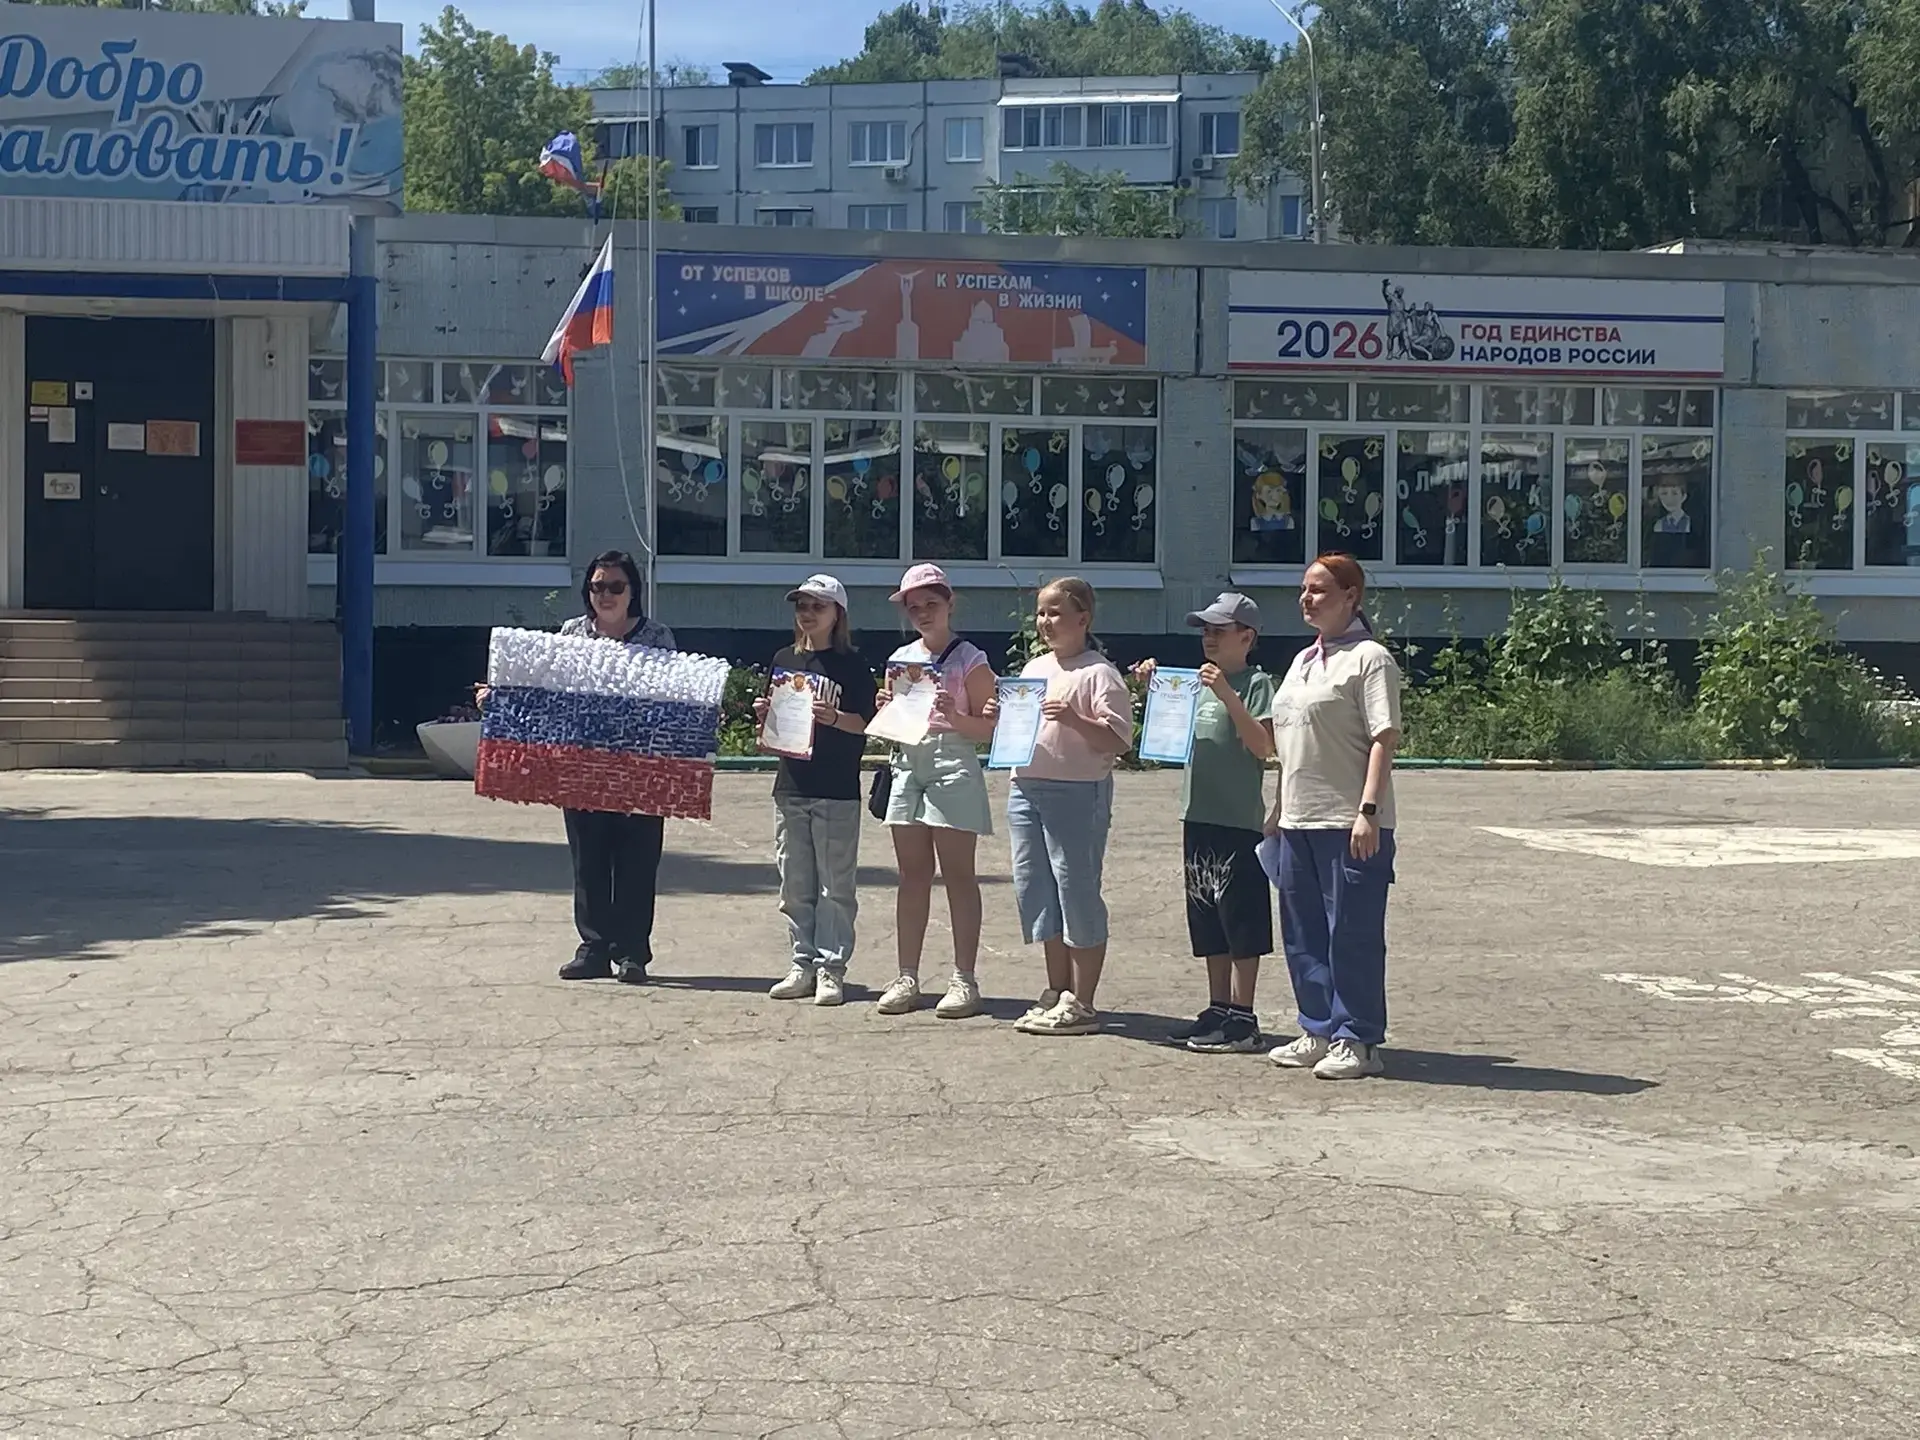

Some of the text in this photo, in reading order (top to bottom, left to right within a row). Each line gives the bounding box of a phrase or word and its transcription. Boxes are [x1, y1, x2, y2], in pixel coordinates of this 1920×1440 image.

[0, 34, 203, 123] Добро
[0, 114, 357, 186] аловать!
[680, 264, 791, 283] ОТ УСПЕХОВ
[936, 273, 1032, 290] К УСПЕХАМ
[744, 284, 756, 300] В
[999, 293, 1083, 309] В ЖИЗНИ!
[1277, 319, 1383, 360] 2026
[1460, 324, 1622, 344] ГОД ЕДИНСТВА
[1460, 345, 1656, 365] НАРОДОВ РОССИИ
